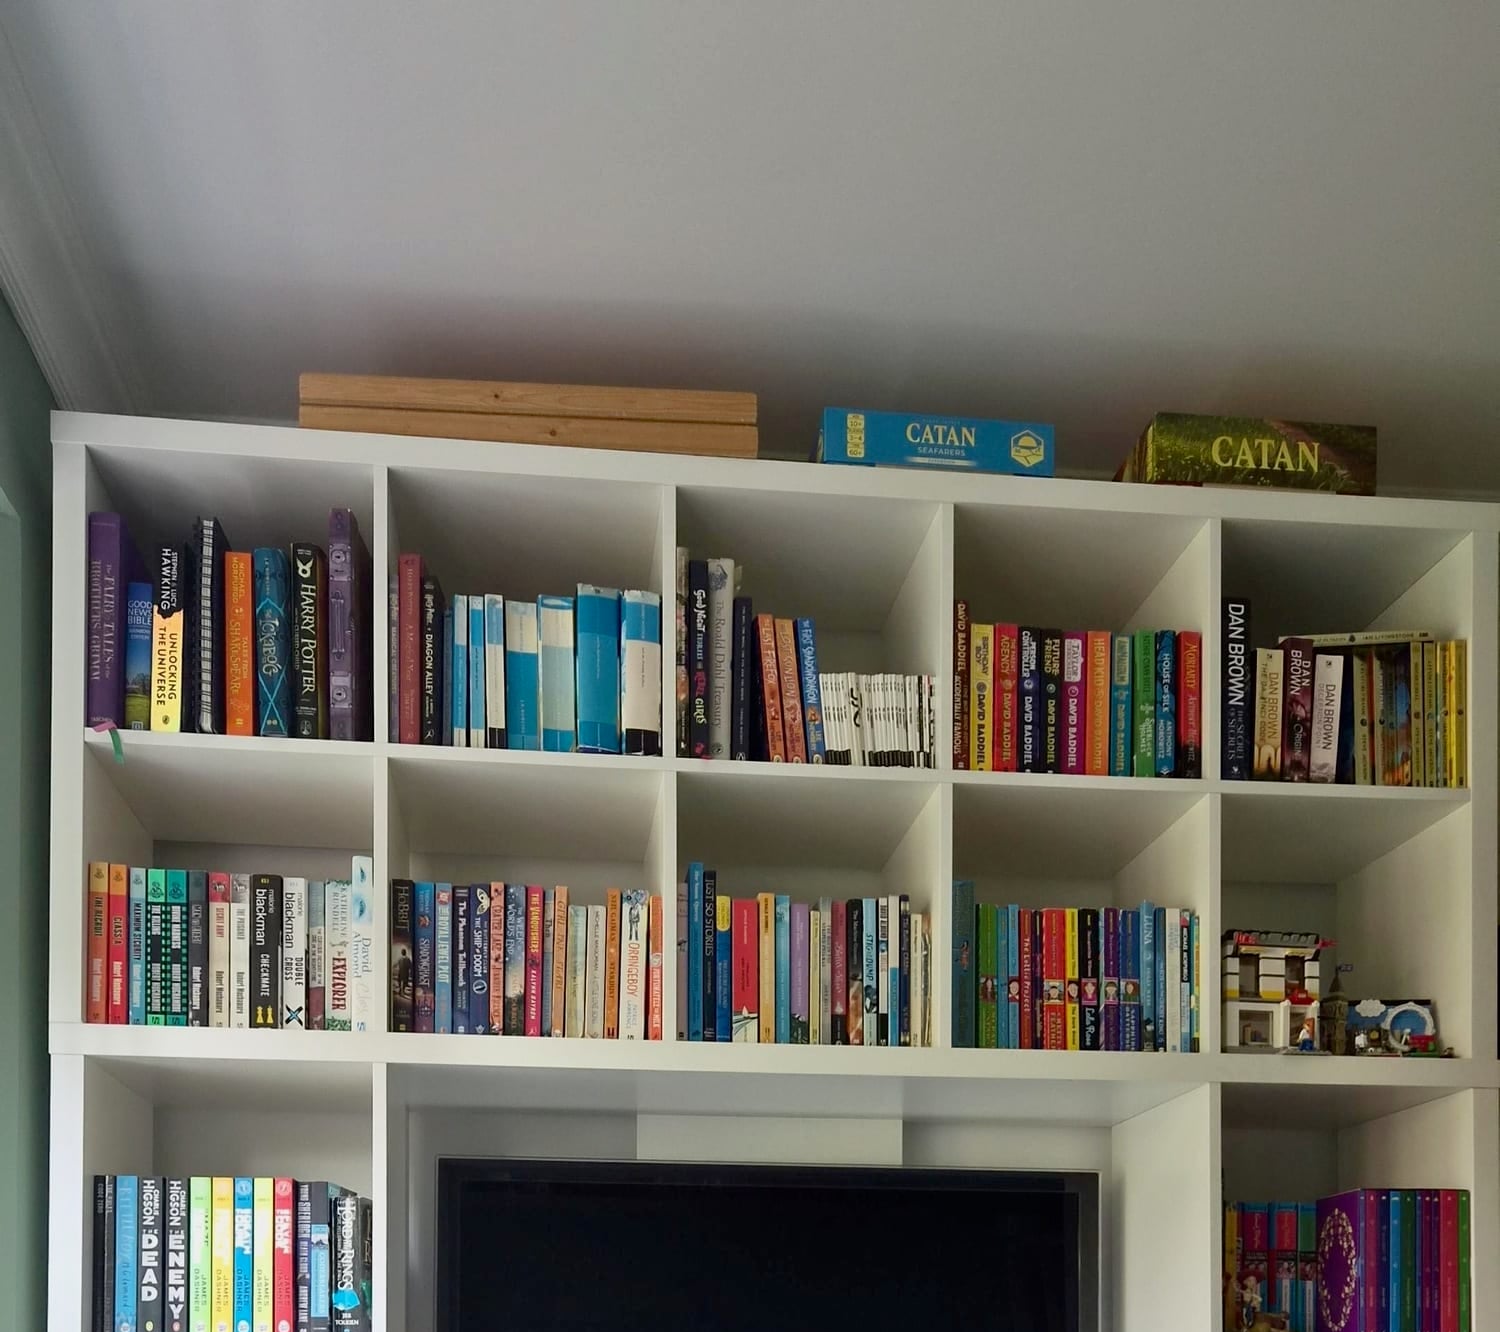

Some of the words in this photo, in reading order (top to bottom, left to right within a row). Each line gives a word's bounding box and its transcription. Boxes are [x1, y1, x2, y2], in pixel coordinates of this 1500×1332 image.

[905, 422, 975, 448] CATAN
[917, 446, 966, 459] SEAFARERS
[1211, 435, 1320, 473] CATAN
[161, 548, 171, 610] HAWKING
[128, 600, 152, 609] GOOD
[301, 584, 316, 635] HARRY
[715, 600, 724, 617] The
[957, 604, 966, 630] DAVID
[127, 616, 152, 625] BIBLE
[714, 618, 725, 650] Roald
[1228, 603, 1244, 639] DAN
[425, 634, 433, 669] DIAGON
[957, 633, 966, 671] BADDIEL
[1000, 635, 1009, 675] AGENCY
[1022, 631, 1030, 677] CONTROLLER
[1094, 638, 1104, 665] HEAD
[1184, 641, 1197, 689] MORIARTY
[156, 649, 166, 706] UNIVERSE
[168, 633, 177, 700] UNLOCKING
[301, 638, 316, 695] POTTER
[714, 653, 724, 680] Dahl
[1162, 653, 1170, 683] HOUSE
[1228, 643, 1244, 705] BROWN
[1290, 650, 1302, 696] BROWN
[1302, 660, 1311, 686] DAN
[425, 671, 433, 694] ALLEY
[1268, 672, 1279, 695] DAN
[1325, 684, 1336, 706] DAN
[710, 683, 724, 729] Treasury
[977, 694, 985, 721] DAVID
[1003, 693, 1011, 719] DAVID
[1024, 696, 1032, 722] DAVID
[1047, 700, 1055, 725] DAVID
[1067, 699, 1077, 725] DAVID
[1117, 704, 1125, 730] DAVID
[1162, 694, 1170, 712] SILK
[1268, 697, 1279, 739] BROWN
[1322, 709, 1334, 750] BROWN
[954, 721, 962, 754] FAMOUS
[977, 724, 985, 764] BADDIEL
[1003, 721, 1011, 761] BADDIEL
[1024, 725, 1032, 764] BADDIEL
[1047, 727, 1055, 764] BADDIEL
[1067, 728, 1077, 768] BADDIEL
[1094, 729, 1102, 770] BADDIEL
[1293, 723, 1303, 755] ORIGIN
[530, 893, 538, 905] THE
[705, 879, 713, 902] JUST
[94, 909, 103, 937] RECRUIT
[133, 903, 141, 932] MAXIMUM
[151, 905, 161, 914] THE
[256, 889, 266, 945] blackman
[285, 892, 295, 948] blackman
[332, 892, 340, 933] RUNDELL
[340, 887, 348, 938] KATHERINE
[458, 901, 466, 916] The
[492, 905, 501, 931] CRATER
[705, 903, 713, 917] SO
[114, 917, 122, 937] CLASS
[151, 915, 161, 935] KILLING
[438, 917, 449, 938] ROYAL
[458, 918, 466, 949] Phantom
[529, 906, 539, 953] VANQUISHERS
[705, 919, 713, 956] STORIES
[1144, 914, 1153, 945] LUNA
[133, 934, 142, 960] SECURITY
[362, 937, 372, 973] David
[438, 940, 449, 964] JEWEL
[492, 933, 501, 951] LAKE
[865, 933, 873, 950] STIG
[151, 963, 161, 981] ROBERT
[172, 964, 181, 982] ROBERT
[193, 967, 202, 982] Robert
[260, 954, 269, 997] CHECKMATE
[284, 957, 293, 980] CROSS
[295, 957, 303, 986] DOUBLE
[438, 965, 449, 983] PLOT
[458, 952, 466, 987] Tollbooth
[474, 954, 482, 977] DOOM
[627, 943, 640, 998] ORANGEBOY
[865, 958, 873, 981] DUMP
[151, 982, 161, 1011] MUCHAMORE
[171, 983, 181, 1012] MUCHAMORE
[192, 983, 201, 1010] Muchamore
[332, 957, 347, 1010] EXPLORER
[143, 1180, 154, 1225] HIGSON
[169, 1181, 181, 1226] HIGSON
[298, 1202, 310, 1238] SHERLOCK
[141, 1234, 158, 1302] DEAD
[168, 1235, 185, 1320] ENEMY
[338, 1249, 354, 1290] RINGS
[299, 1310, 308, 1323] LANE
